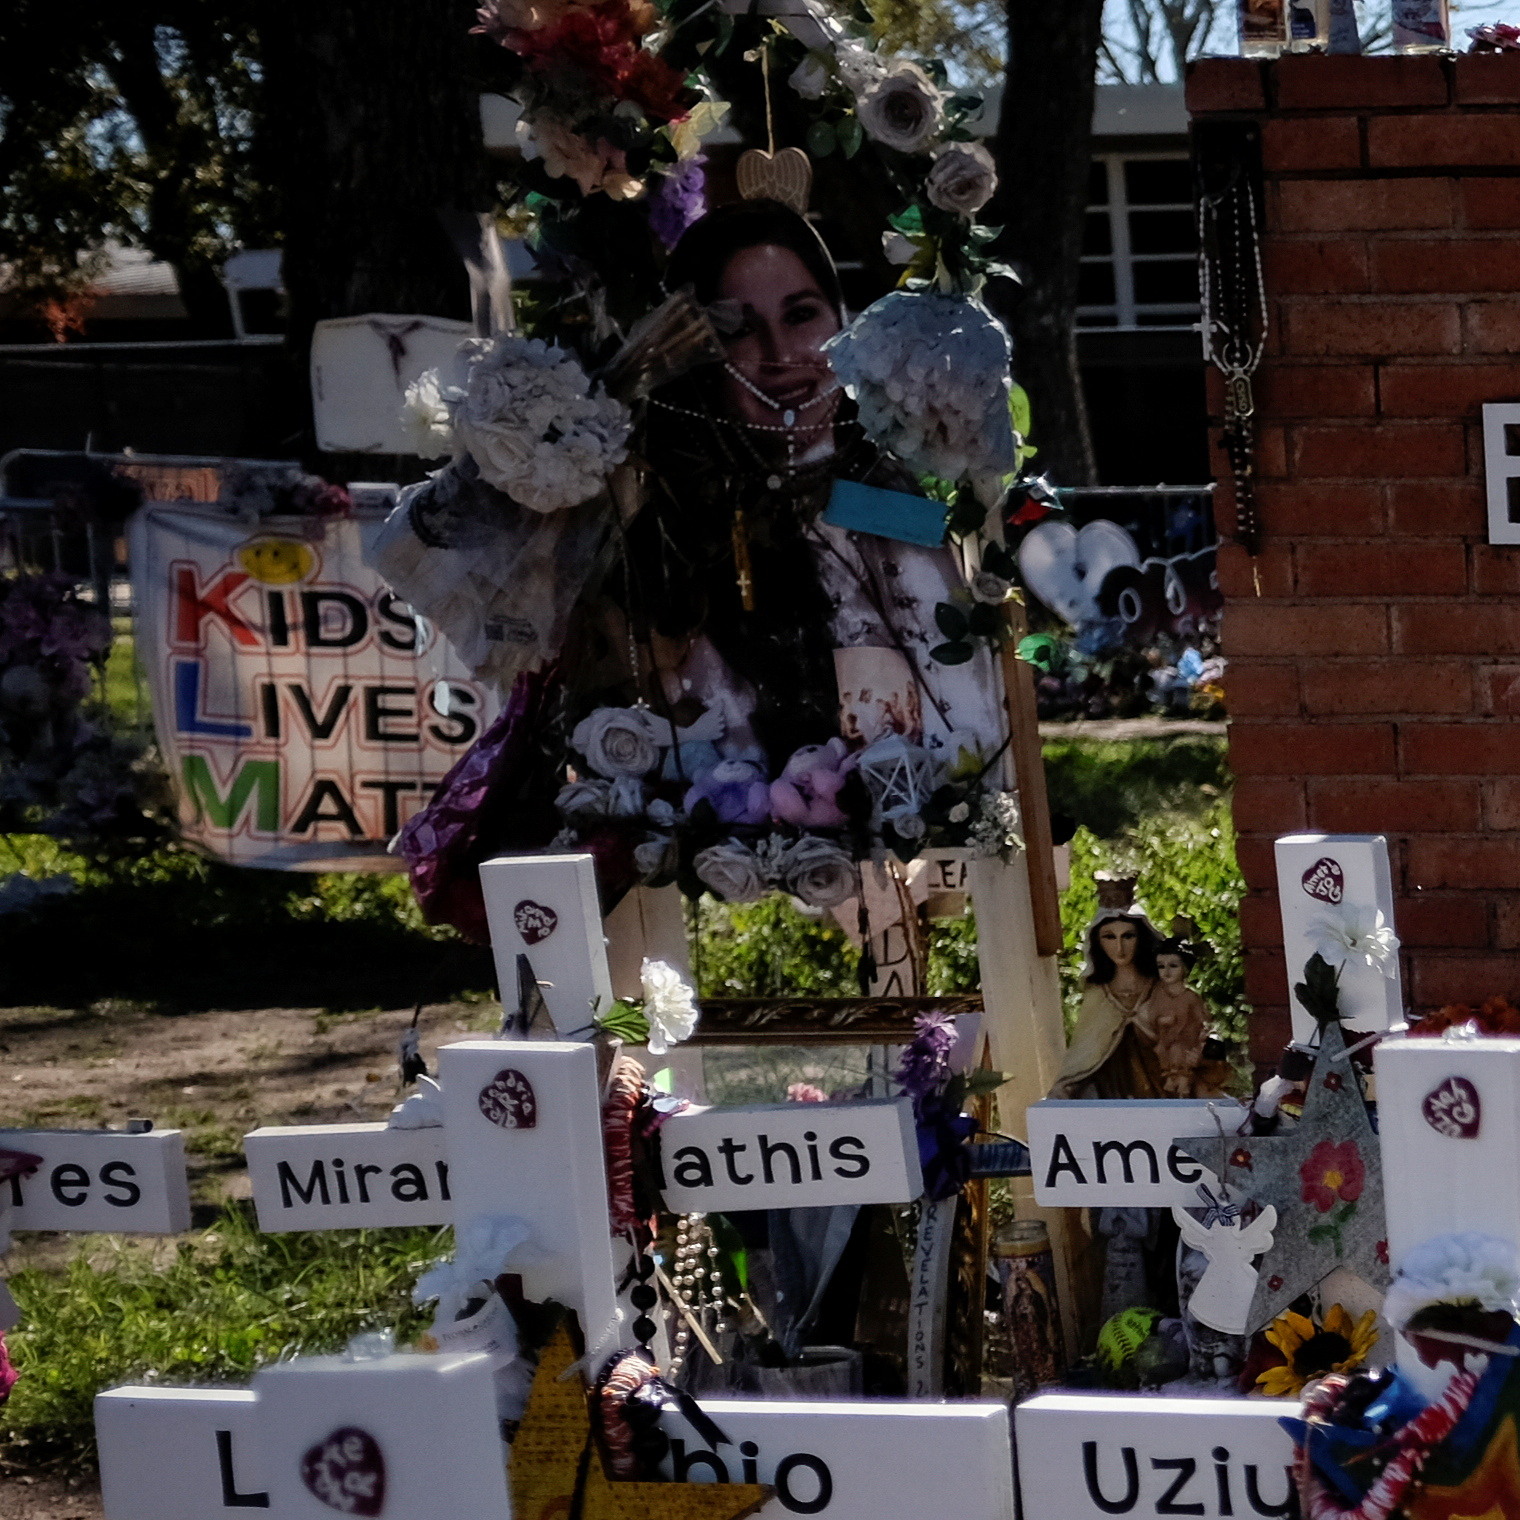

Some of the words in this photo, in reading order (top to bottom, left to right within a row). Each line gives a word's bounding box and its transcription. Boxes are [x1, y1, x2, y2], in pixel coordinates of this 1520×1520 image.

[172, 566, 426, 652] KIDS
[174, 661, 481, 745] LIVES
[658, 1130, 871, 1190] athis
[215, 1430, 271, 1509] L
